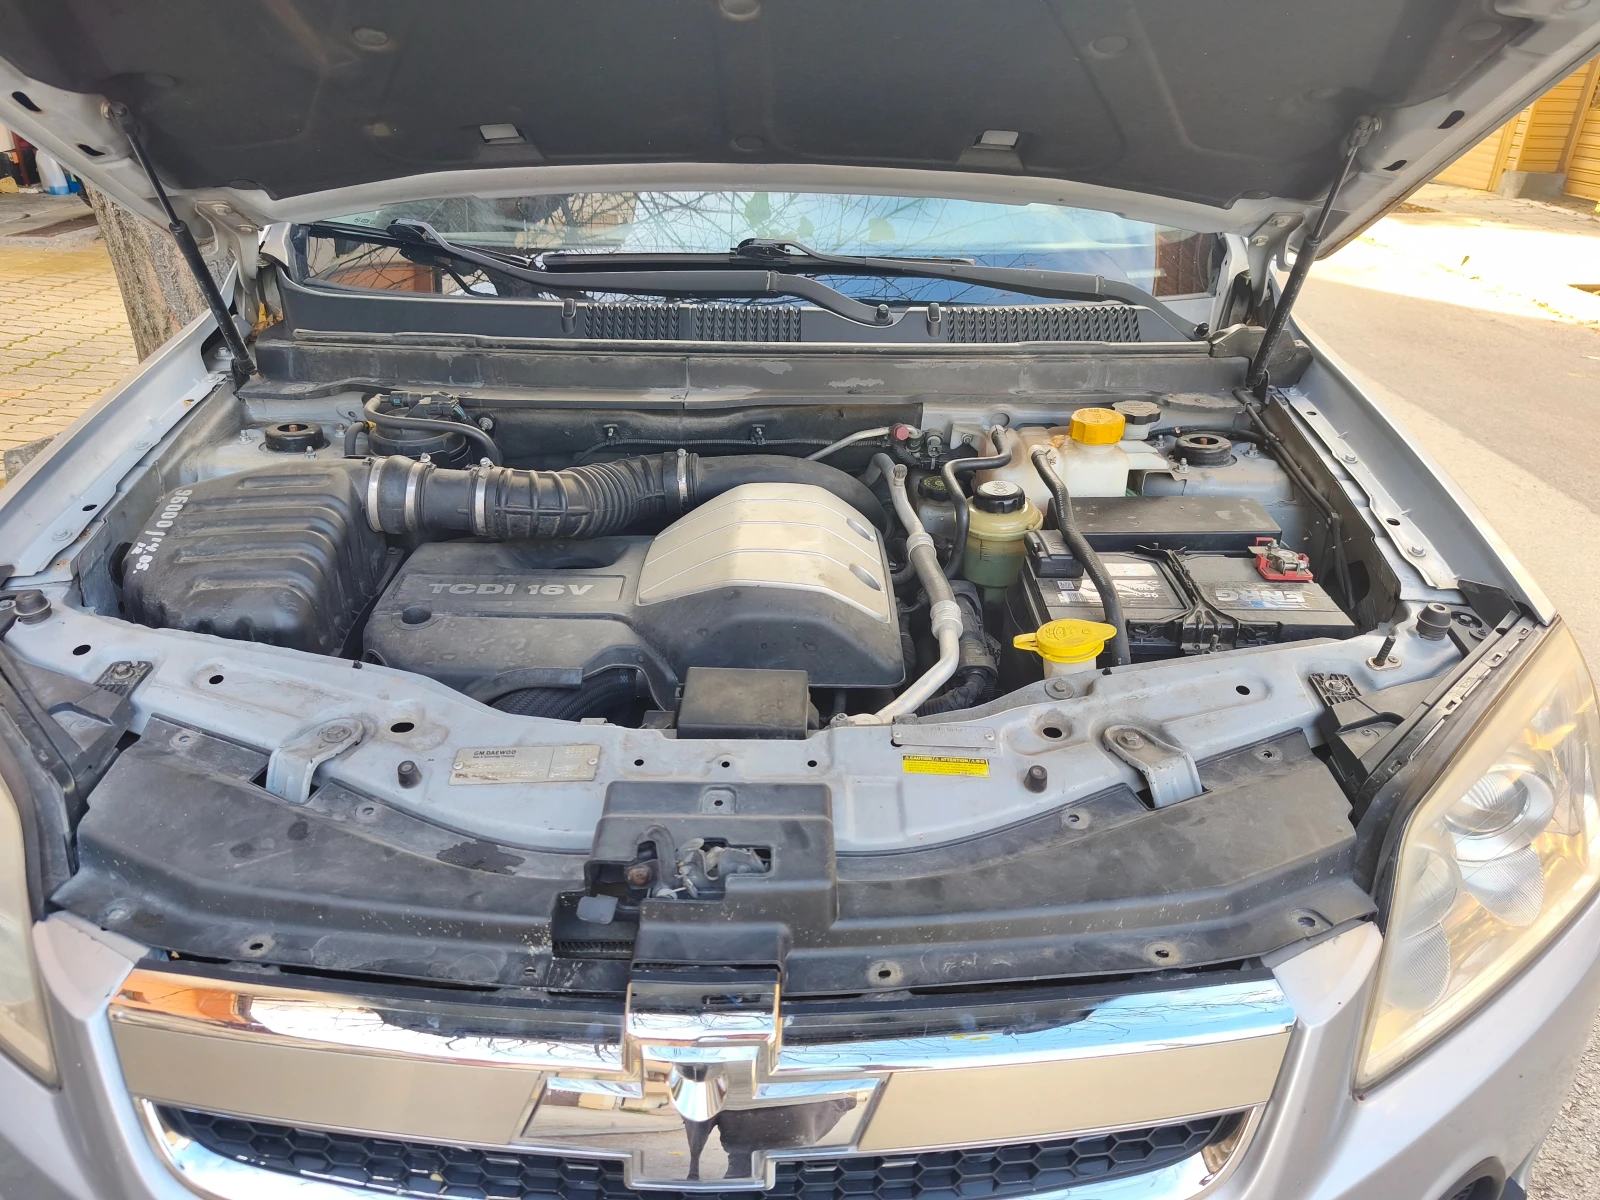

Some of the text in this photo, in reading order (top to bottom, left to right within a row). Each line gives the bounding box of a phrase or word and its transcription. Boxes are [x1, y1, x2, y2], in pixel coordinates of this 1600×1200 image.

[156, 489, 193, 527] 96000
[527, 584, 594, 596] 16V
[1214, 589, 1305, 603] ENRG
